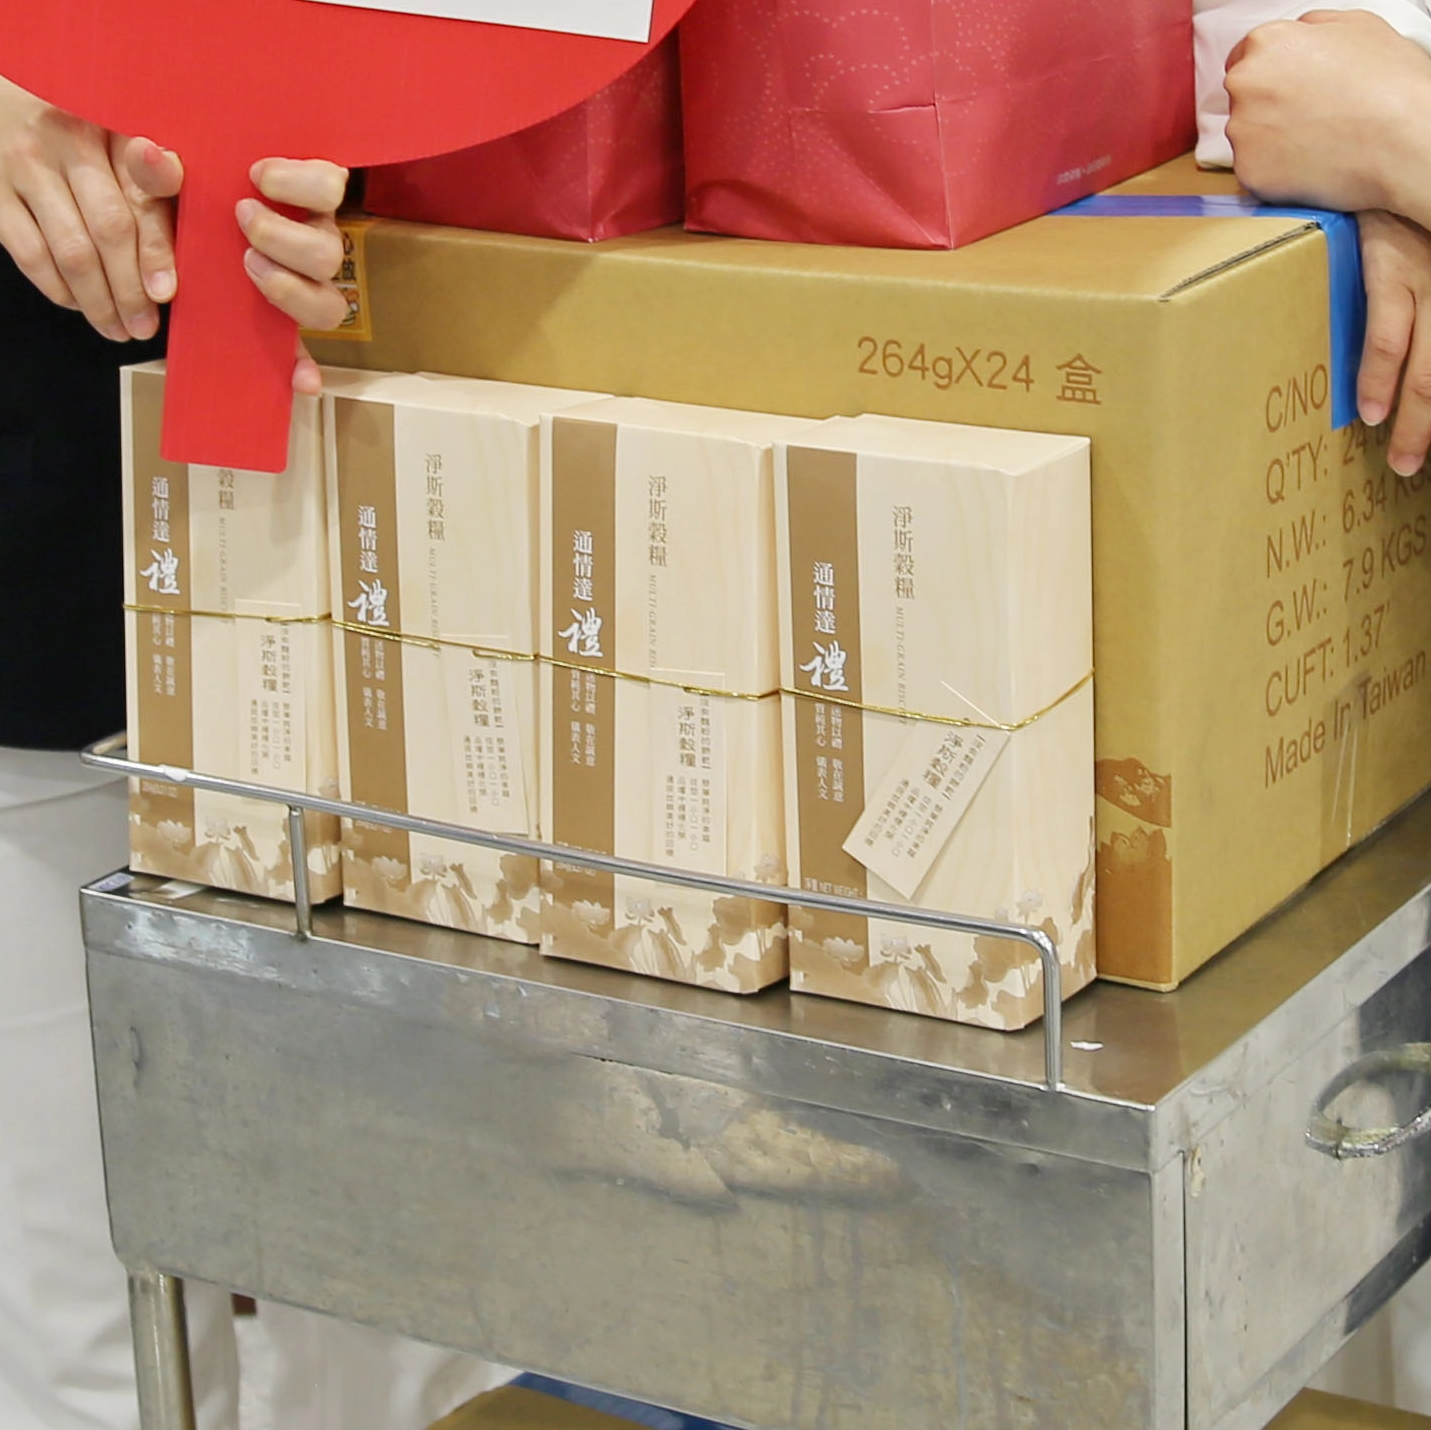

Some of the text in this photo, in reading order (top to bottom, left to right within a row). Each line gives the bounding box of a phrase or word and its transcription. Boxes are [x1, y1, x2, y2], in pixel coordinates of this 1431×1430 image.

[857, 336, 1103, 406] 264gX24 盒
[1266, 363, 1328, 432] C/NO
[425, 453, 445, 542] 淨斯穀糧
[648, 475, 668, 567] 淨斯穀糧
[1267, 513, 1327, 578] N.W.:
[1342, 476, 1387, 533] 6.34
[346, 505, 391, 627] 通情達禮
[557, 530, 604, 658] 通情達禮
[892, 505, 915, 601] 淨斯穀糧
[1266, 514, 1428, 647] G.W.: 7.9 KGS
[800, 561, 850, 692] 通情達禮
[1264, 648, 1427, 790] Made In Taiwan
[1266, 635, 1338, 718] CUFT:
